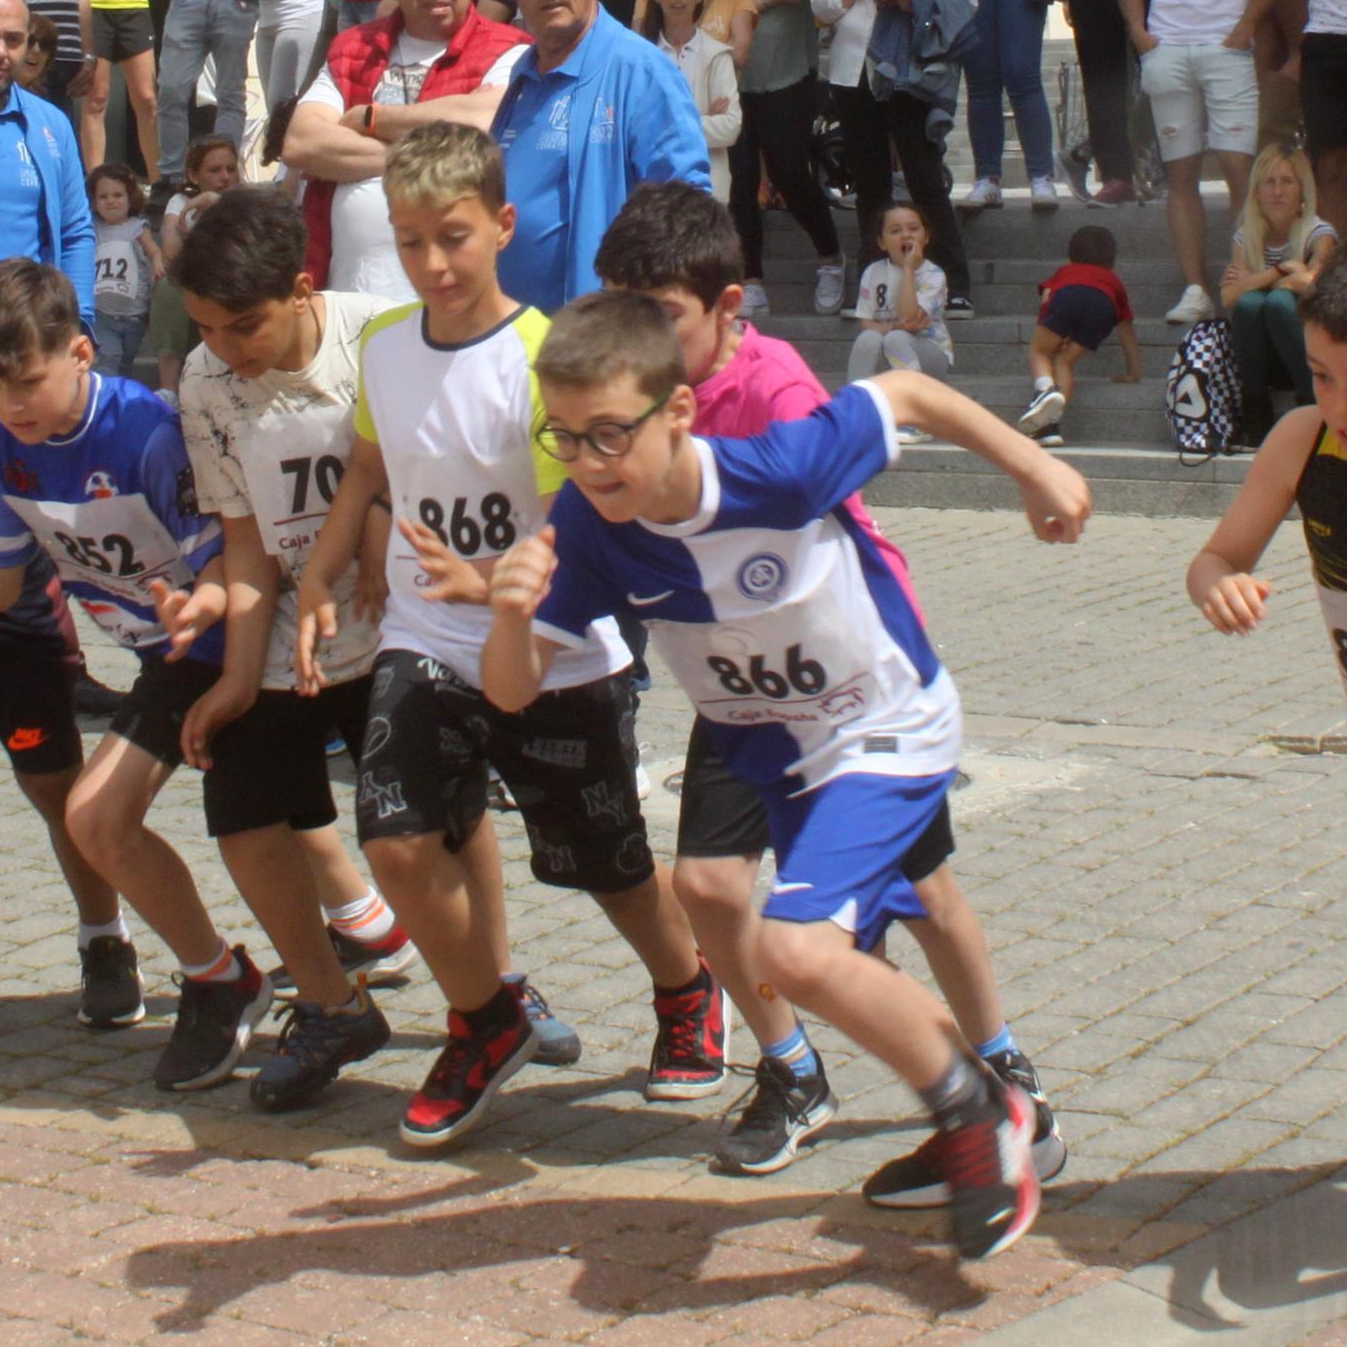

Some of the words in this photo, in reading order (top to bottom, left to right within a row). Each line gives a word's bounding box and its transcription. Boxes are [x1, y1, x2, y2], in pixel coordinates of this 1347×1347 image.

[279, 531, 311, 551] Caja
[419, 492, 517, 556] 868
[53, 530, 146, 577] 852
[707, 643, 827, 699] 866
